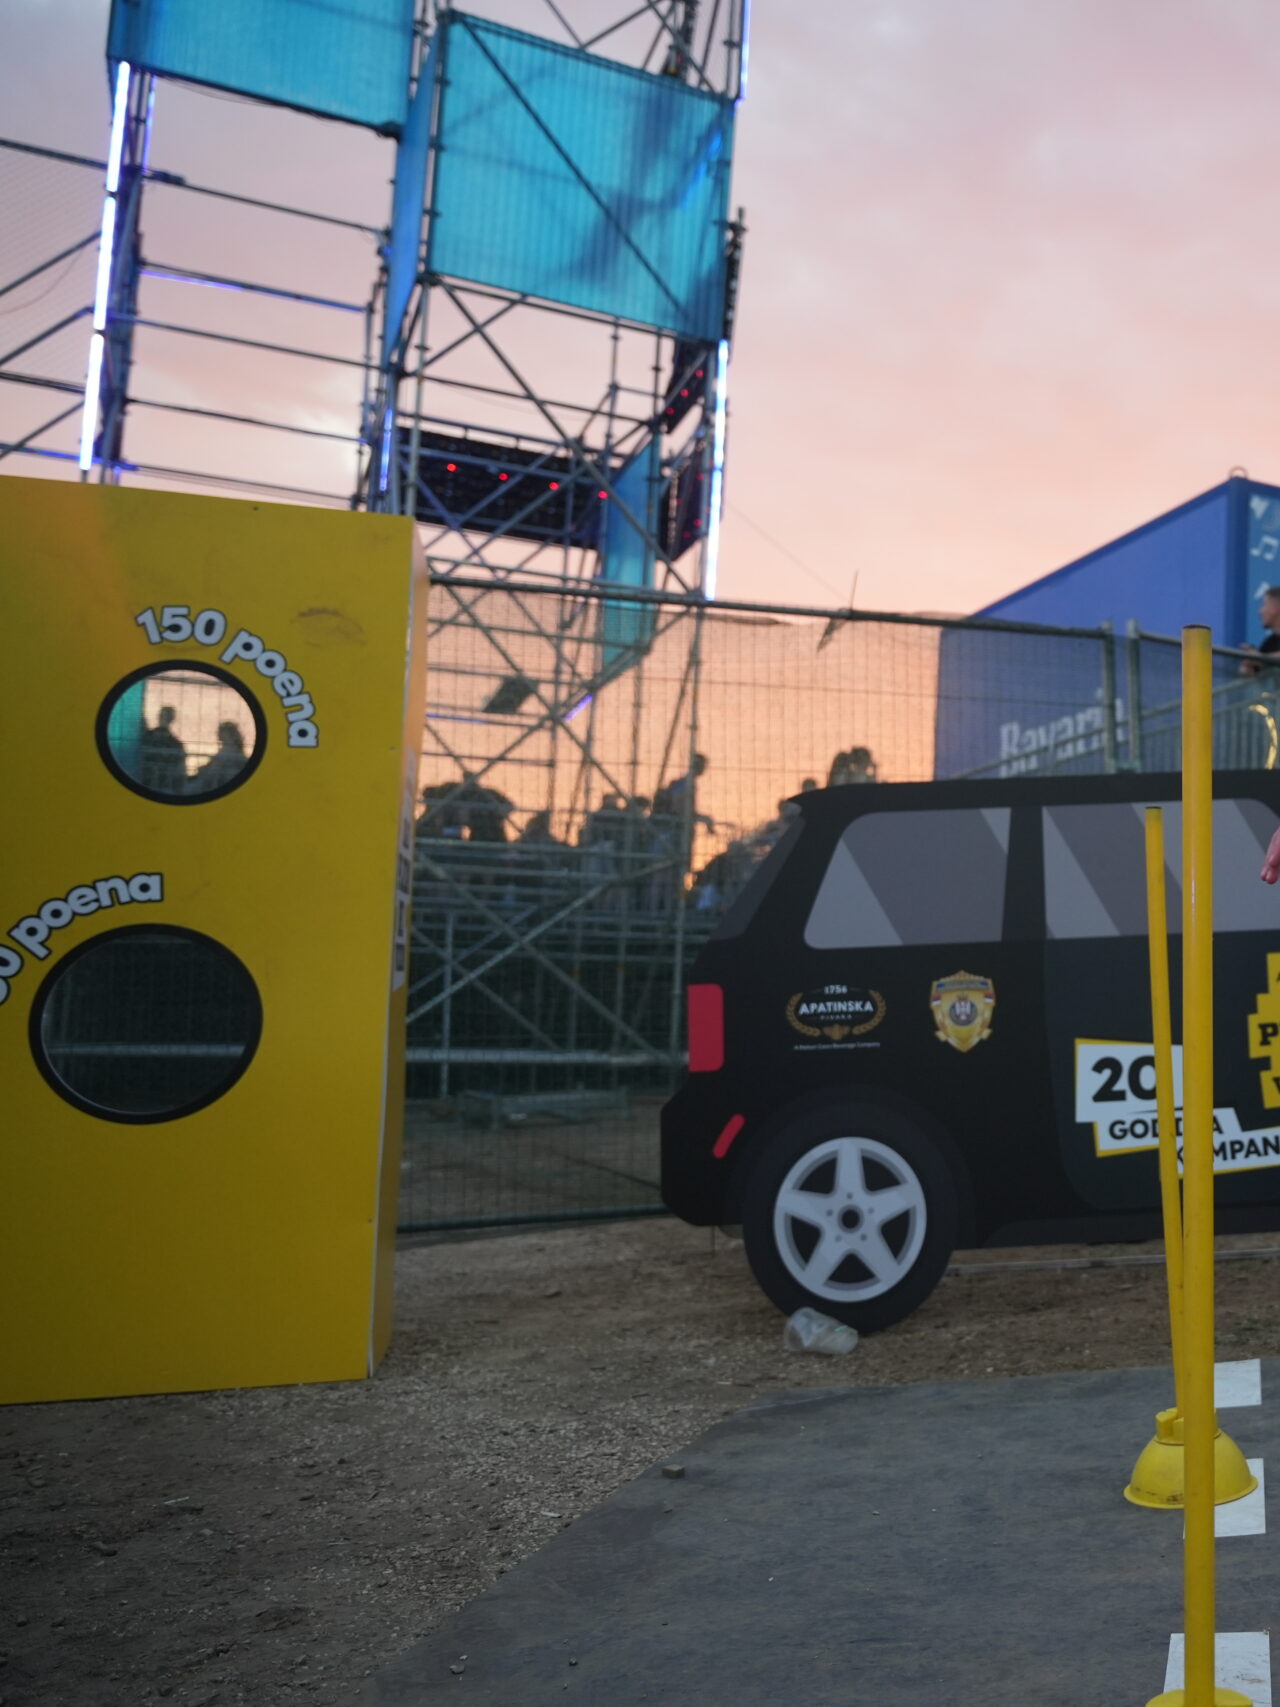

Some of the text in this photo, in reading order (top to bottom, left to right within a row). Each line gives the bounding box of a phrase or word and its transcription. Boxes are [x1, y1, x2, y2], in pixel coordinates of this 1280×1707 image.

[135, 605, 320, 748] 150 poena
[7, 872, 163, 961] poena
[799, 1000, 874, 1016] APATINSKA
[824, 984, 848, 994] 1756
